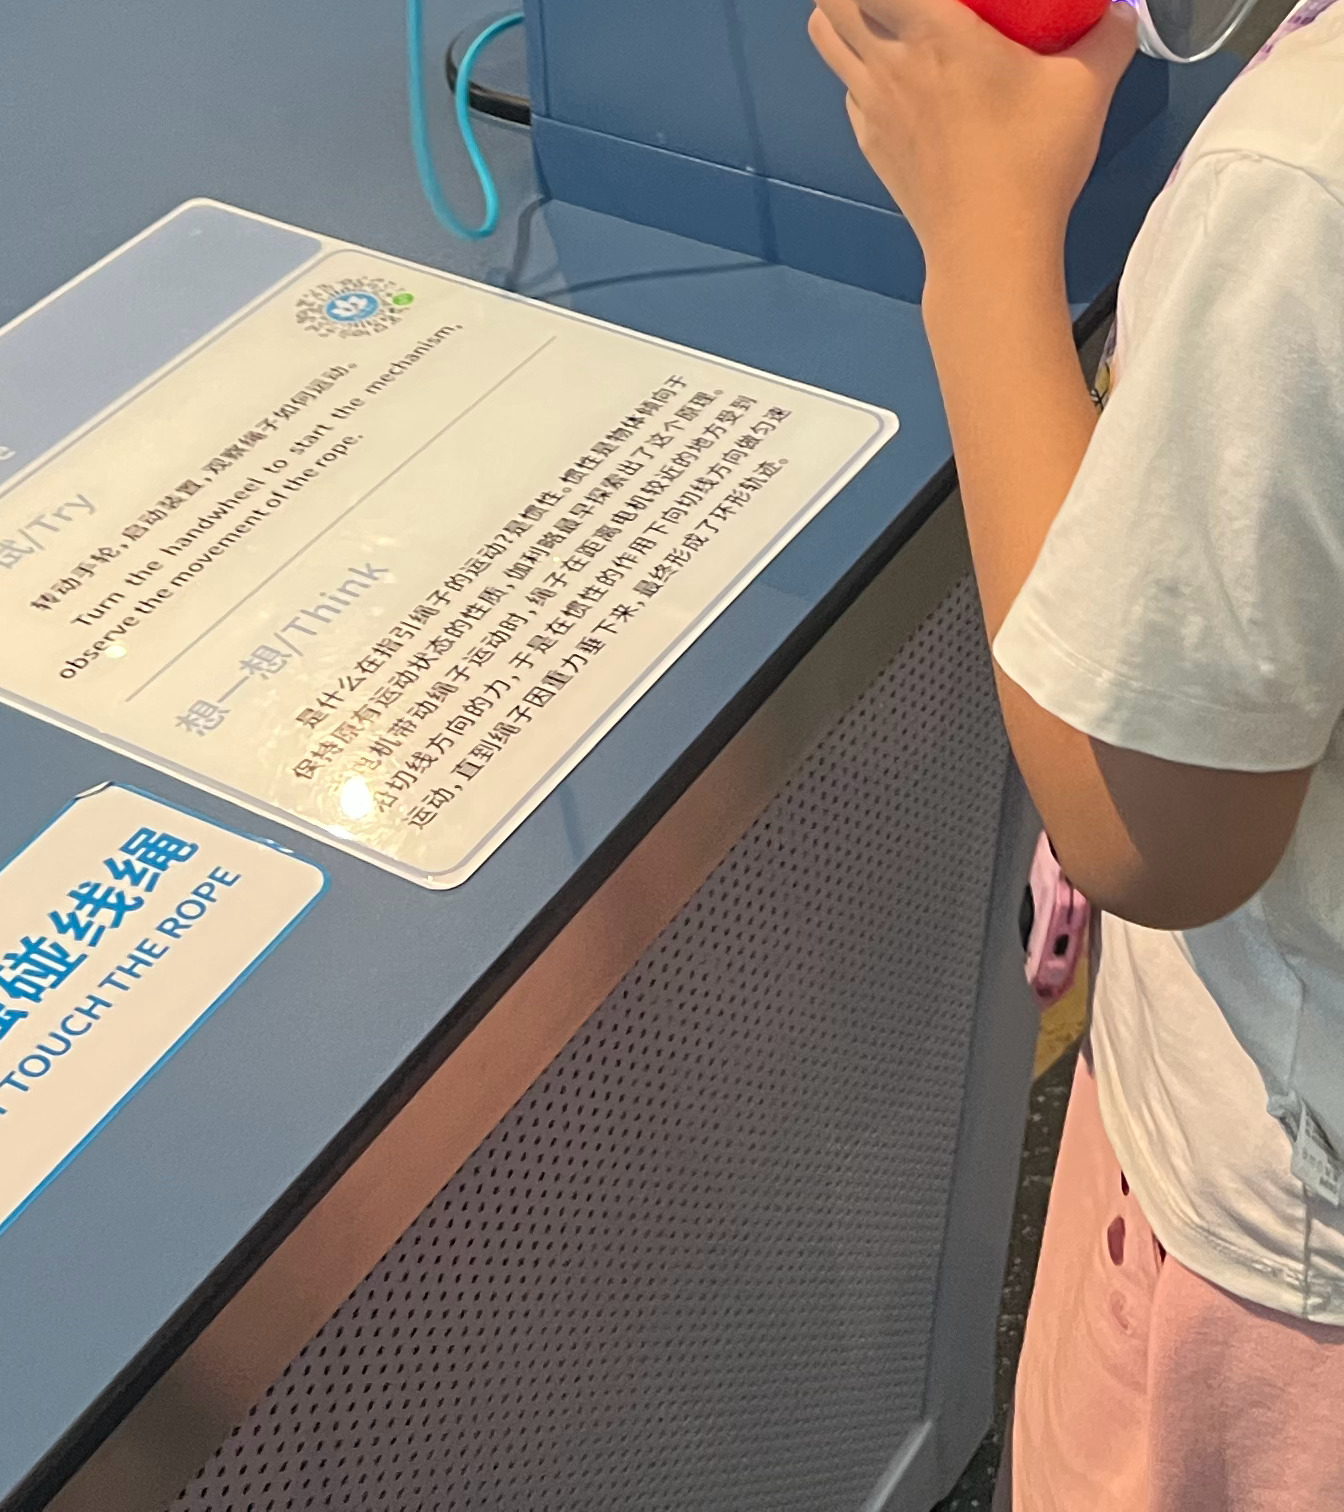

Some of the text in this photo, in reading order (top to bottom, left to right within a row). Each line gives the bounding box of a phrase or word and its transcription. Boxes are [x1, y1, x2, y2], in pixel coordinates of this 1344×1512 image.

[58, 433, 364, 680] observe the movement of the rope.
[70, 324, 463, 626] Turn the handwheel to start the mechanism,
[174, 562, 390, 737] 想一想/Think
[98, 938, 170, 991] THE
[155, 866, 241, 939] ROPE
